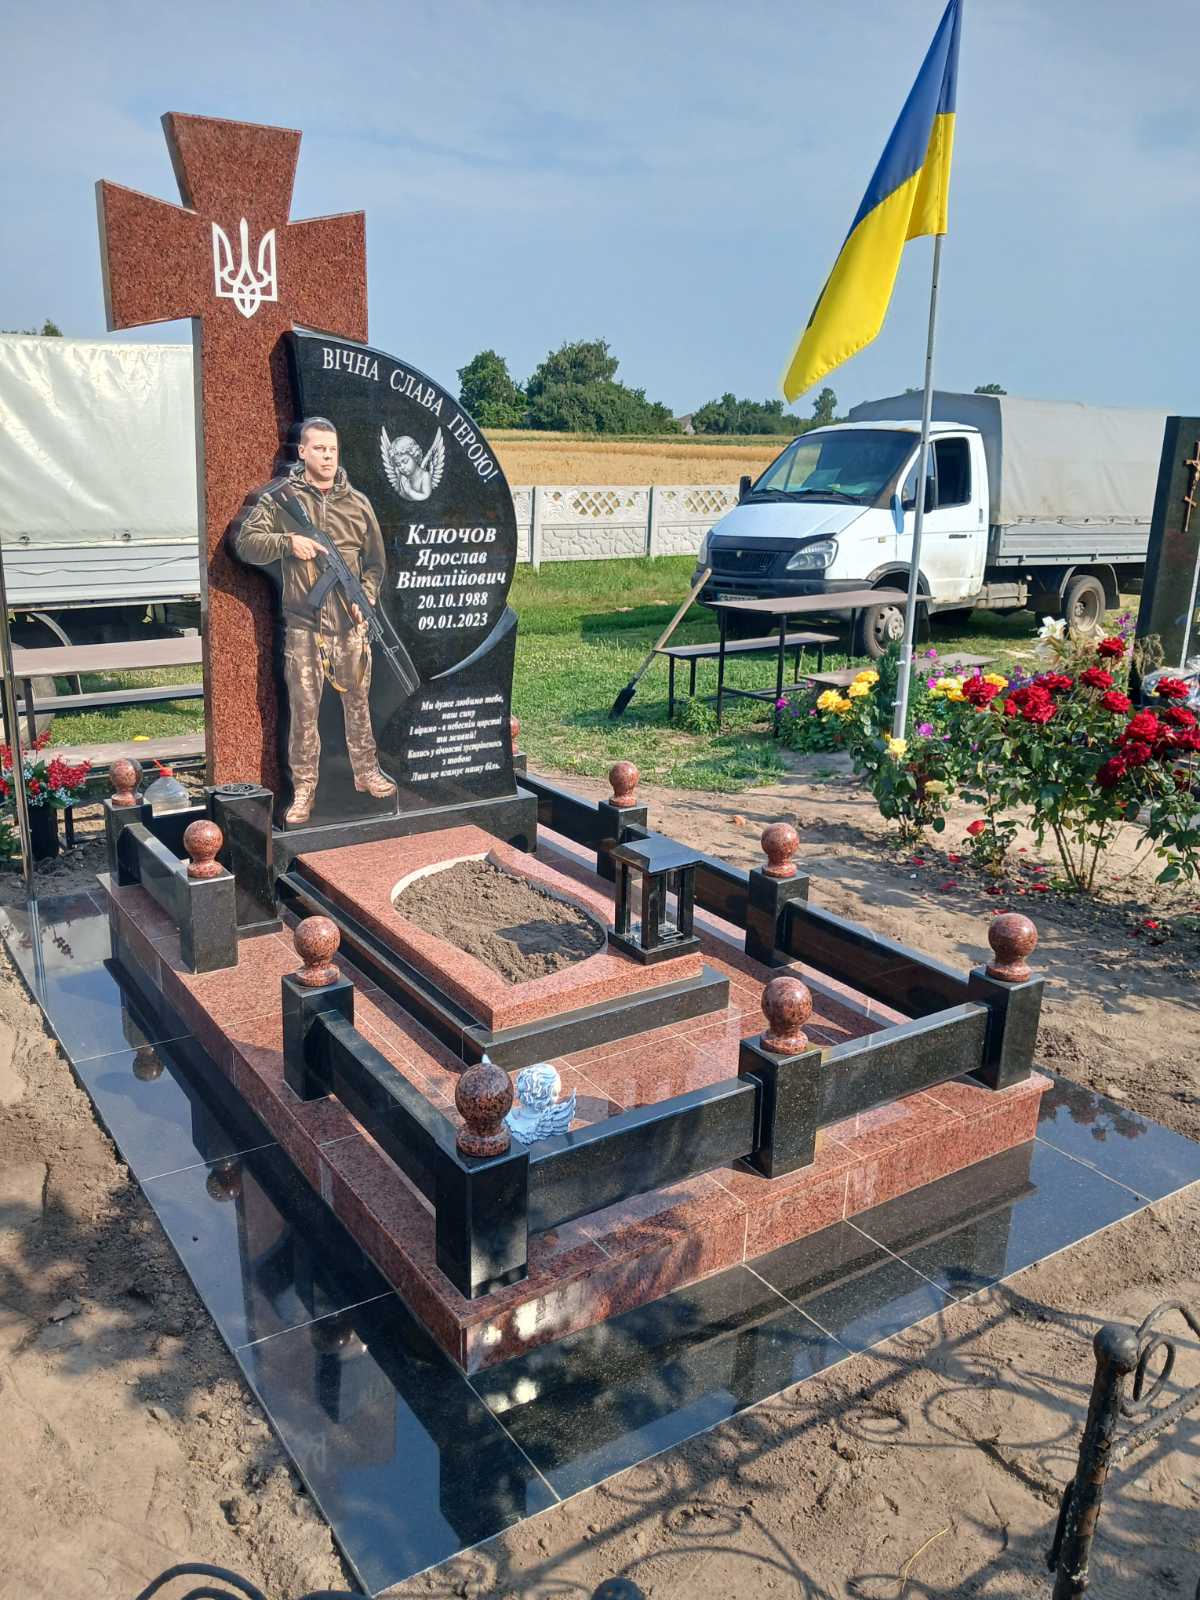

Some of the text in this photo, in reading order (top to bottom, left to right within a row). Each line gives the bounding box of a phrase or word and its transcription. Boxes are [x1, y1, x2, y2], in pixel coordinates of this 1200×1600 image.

[322, 348, 498, 483] ВІЧНА СЛАВА ГЕРОЮ!
[406, 524, 497, 545] Ключов
[416, 548, 488, 571] Ярослав
[396, 569, 506, 589] Віталійович
[417, 592, 488, 609] 20.10.1988
[418, 613, 488, 630] 09.01.2023
[421, 701, 434, 711] Ми
[435, 700, 454, 712] дуже
[455, 697, 483, 707] любимо
[442, 710, 476, 720] наш сину
[436, 730, 477, 743] ти живий!
[447, 755, 472, 765] тобою
[410, 772, 429, 782] Лиш
[430, 770, 439, 780] це
[465, 764, 484, 775] нашу
